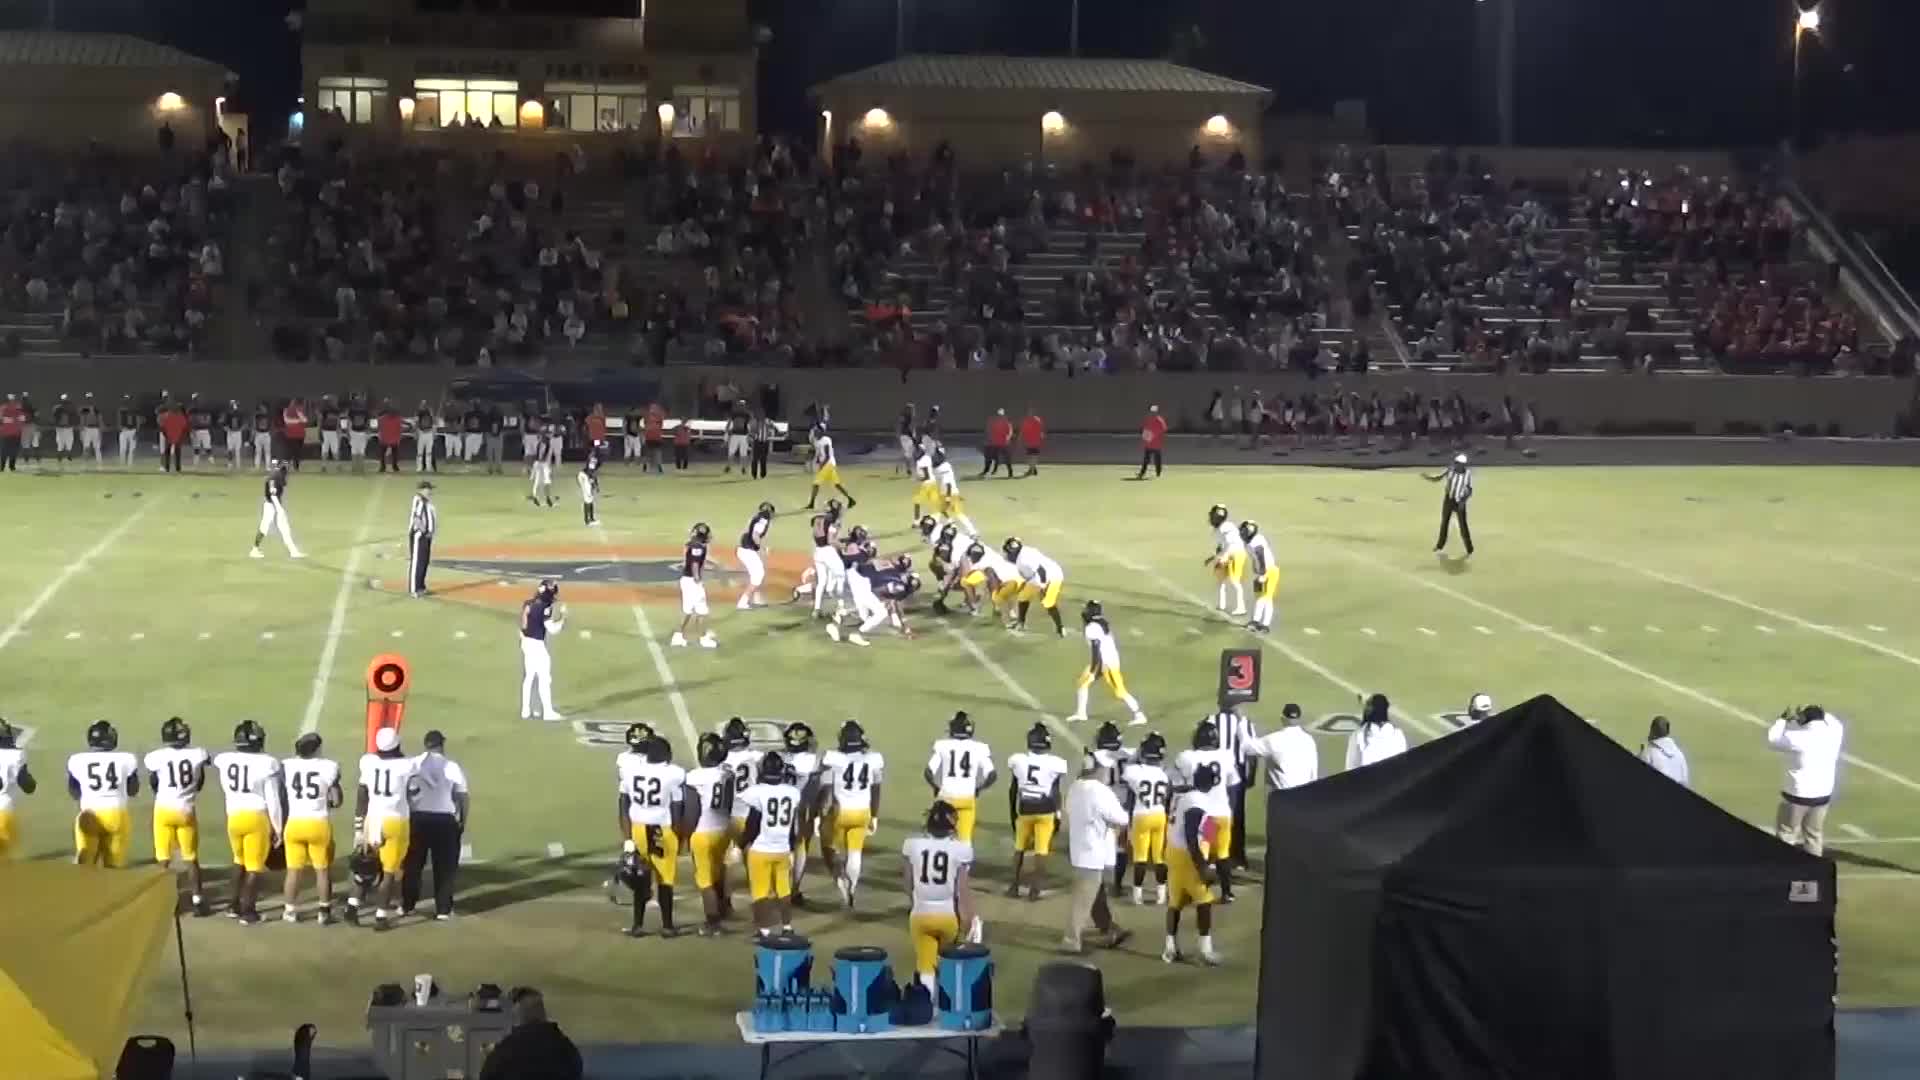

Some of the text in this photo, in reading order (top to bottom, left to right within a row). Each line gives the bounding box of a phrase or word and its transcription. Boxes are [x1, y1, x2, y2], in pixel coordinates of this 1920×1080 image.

[1227, 655, 1254, 689] 3
[87, 762, 119, 791] 54
[167, 759, 193, 788] 18
[229, 763, 250, 792] 91
[843, 761, 869, 790] 44
[949, 750, 971, 778] 14
[1027, 765, 1039, 786] 5
[292, 772, 319, 801] 45
[374, 768, 393, 797] 11
[633, 776, 661, 806] 52
[1139, 780, 1165, 808] 26
[767, 797, 792, 827] 93
[919, 850, 949, 884] 19
